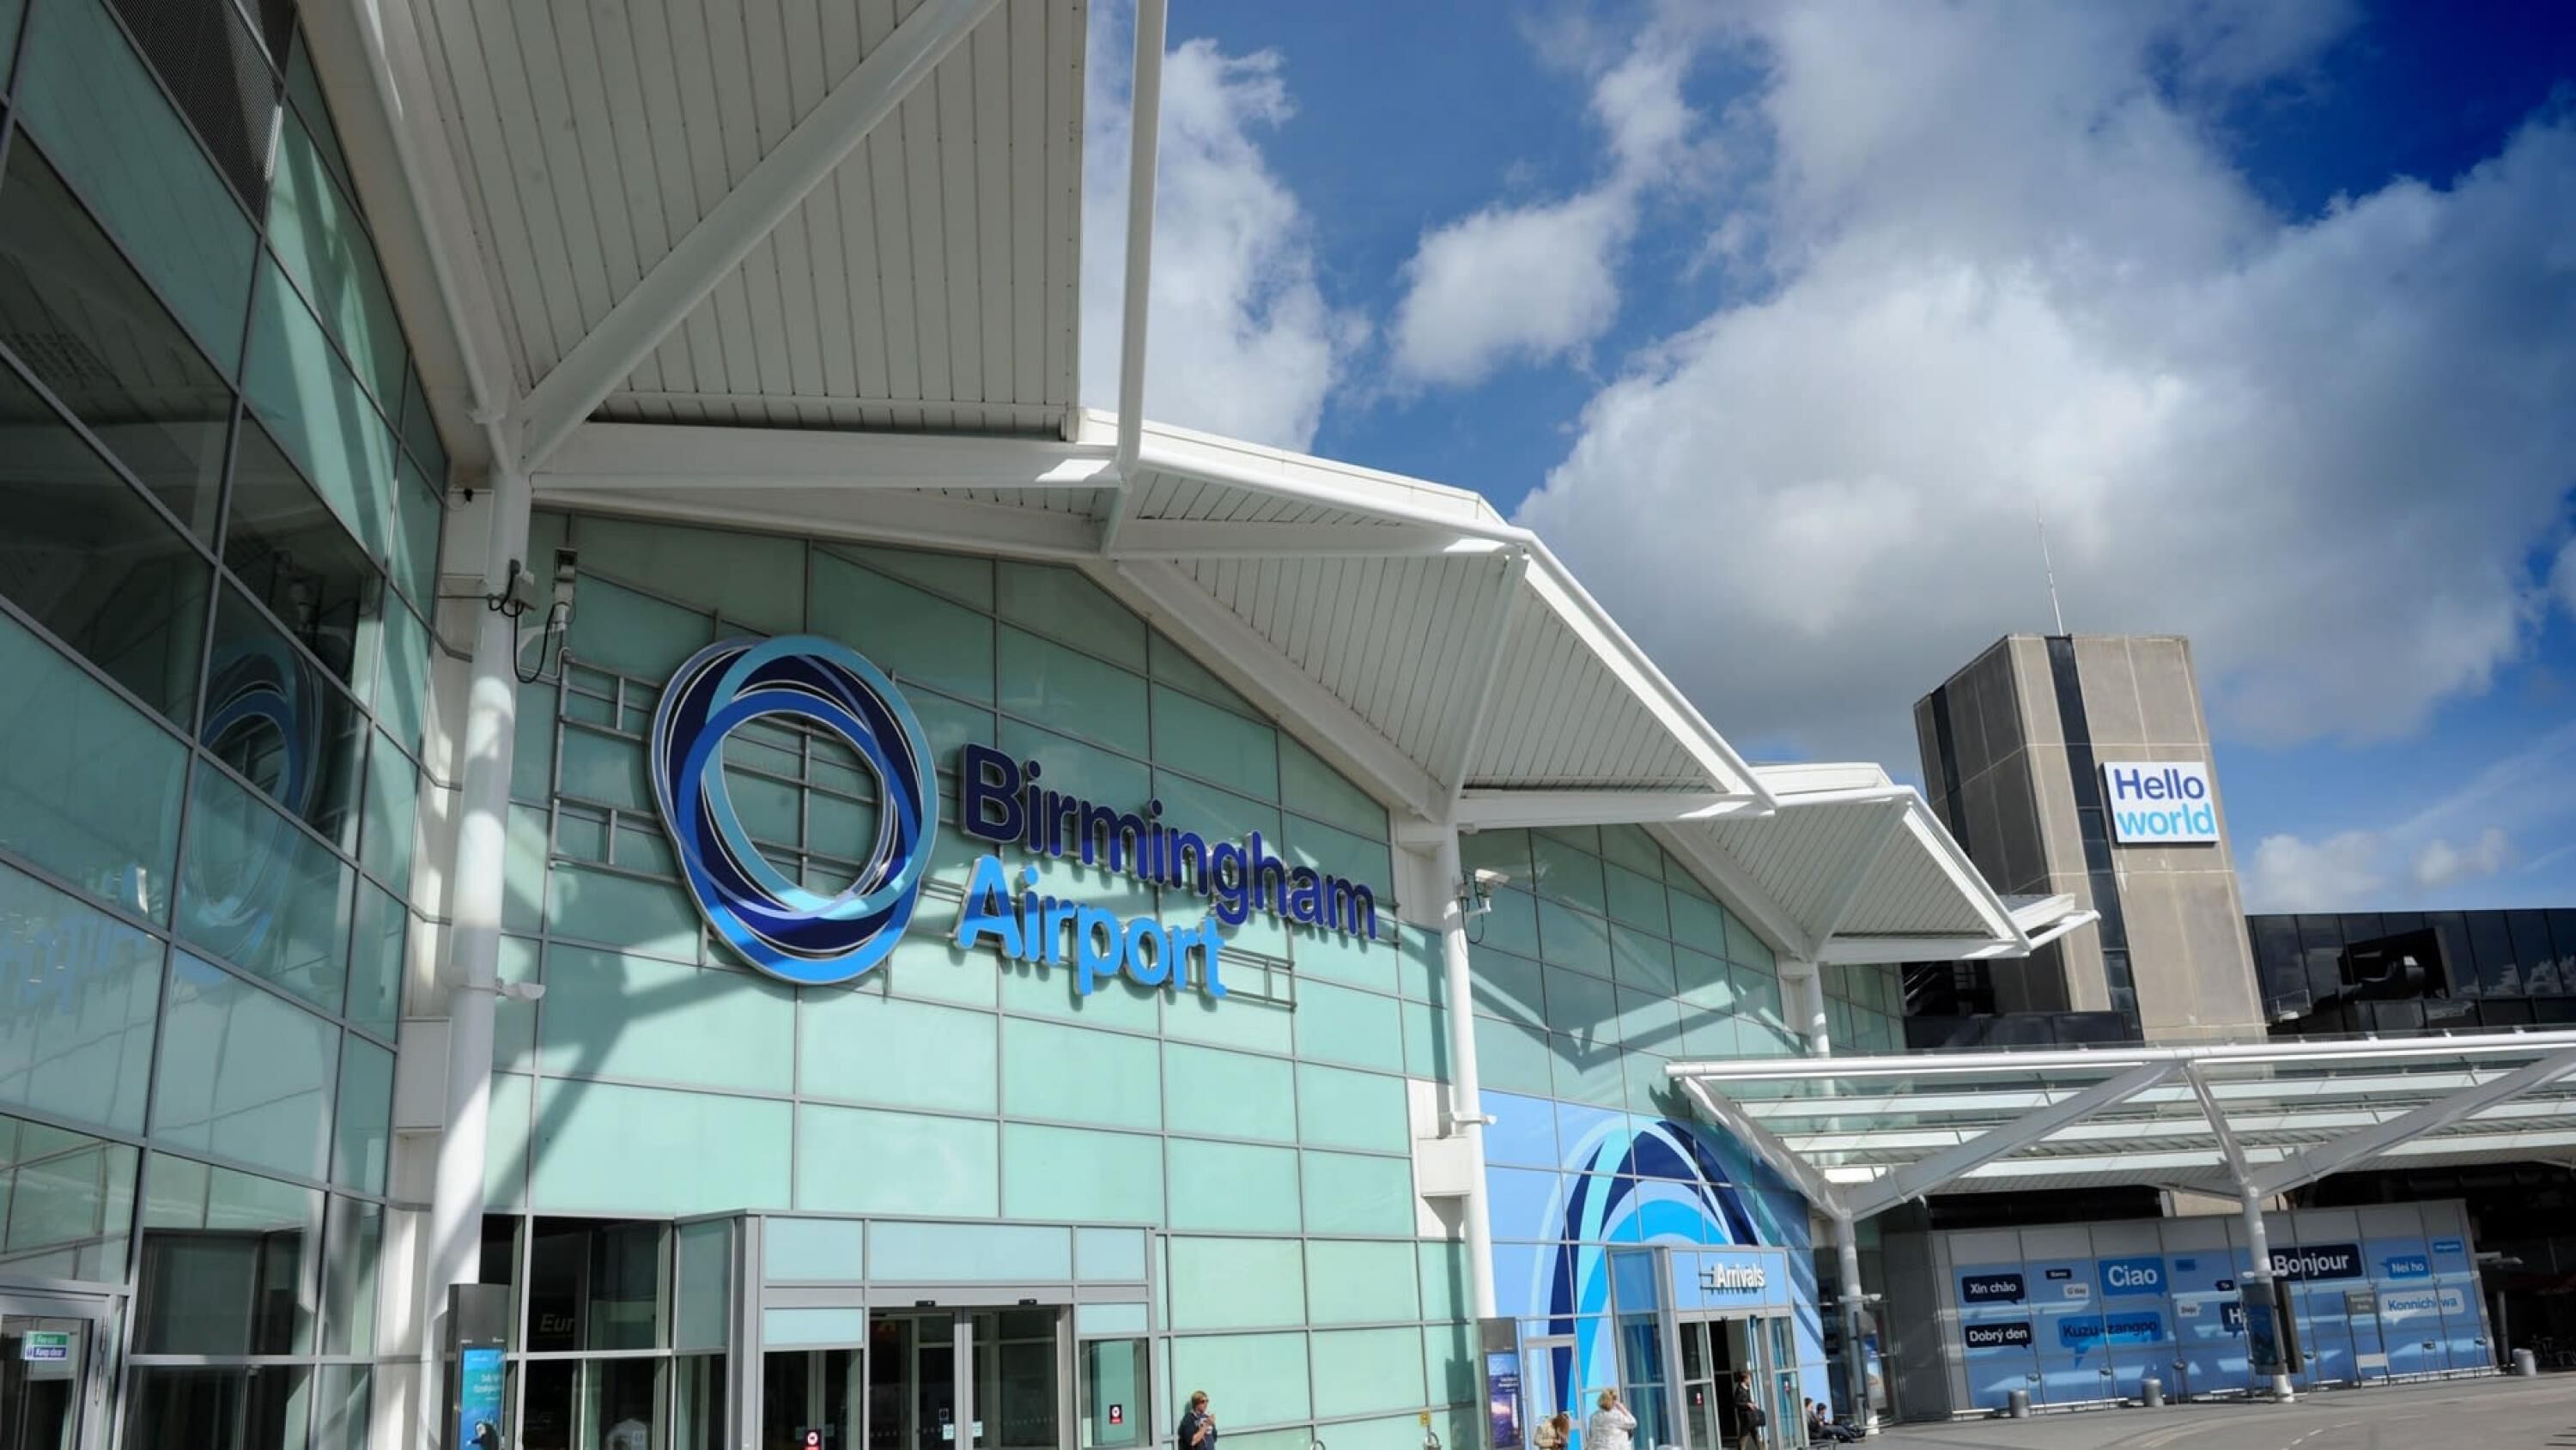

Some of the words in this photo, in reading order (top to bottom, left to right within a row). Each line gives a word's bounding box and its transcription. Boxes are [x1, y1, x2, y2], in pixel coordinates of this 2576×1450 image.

[2113, 768, 2205, 799] Hello
[2115, 803, 2215, 835] world
[960, 742, 1376, 940] Birmingham
[954, 854, 1228, 998] Airport
[1715, 1263, 1765, 1288] Arrivals
[2108, 1265, 2158, 1287] Ciao
[2272, 1253, 2349, 1276] Bonjour
[539, 1313, 574, 1332] Eur
